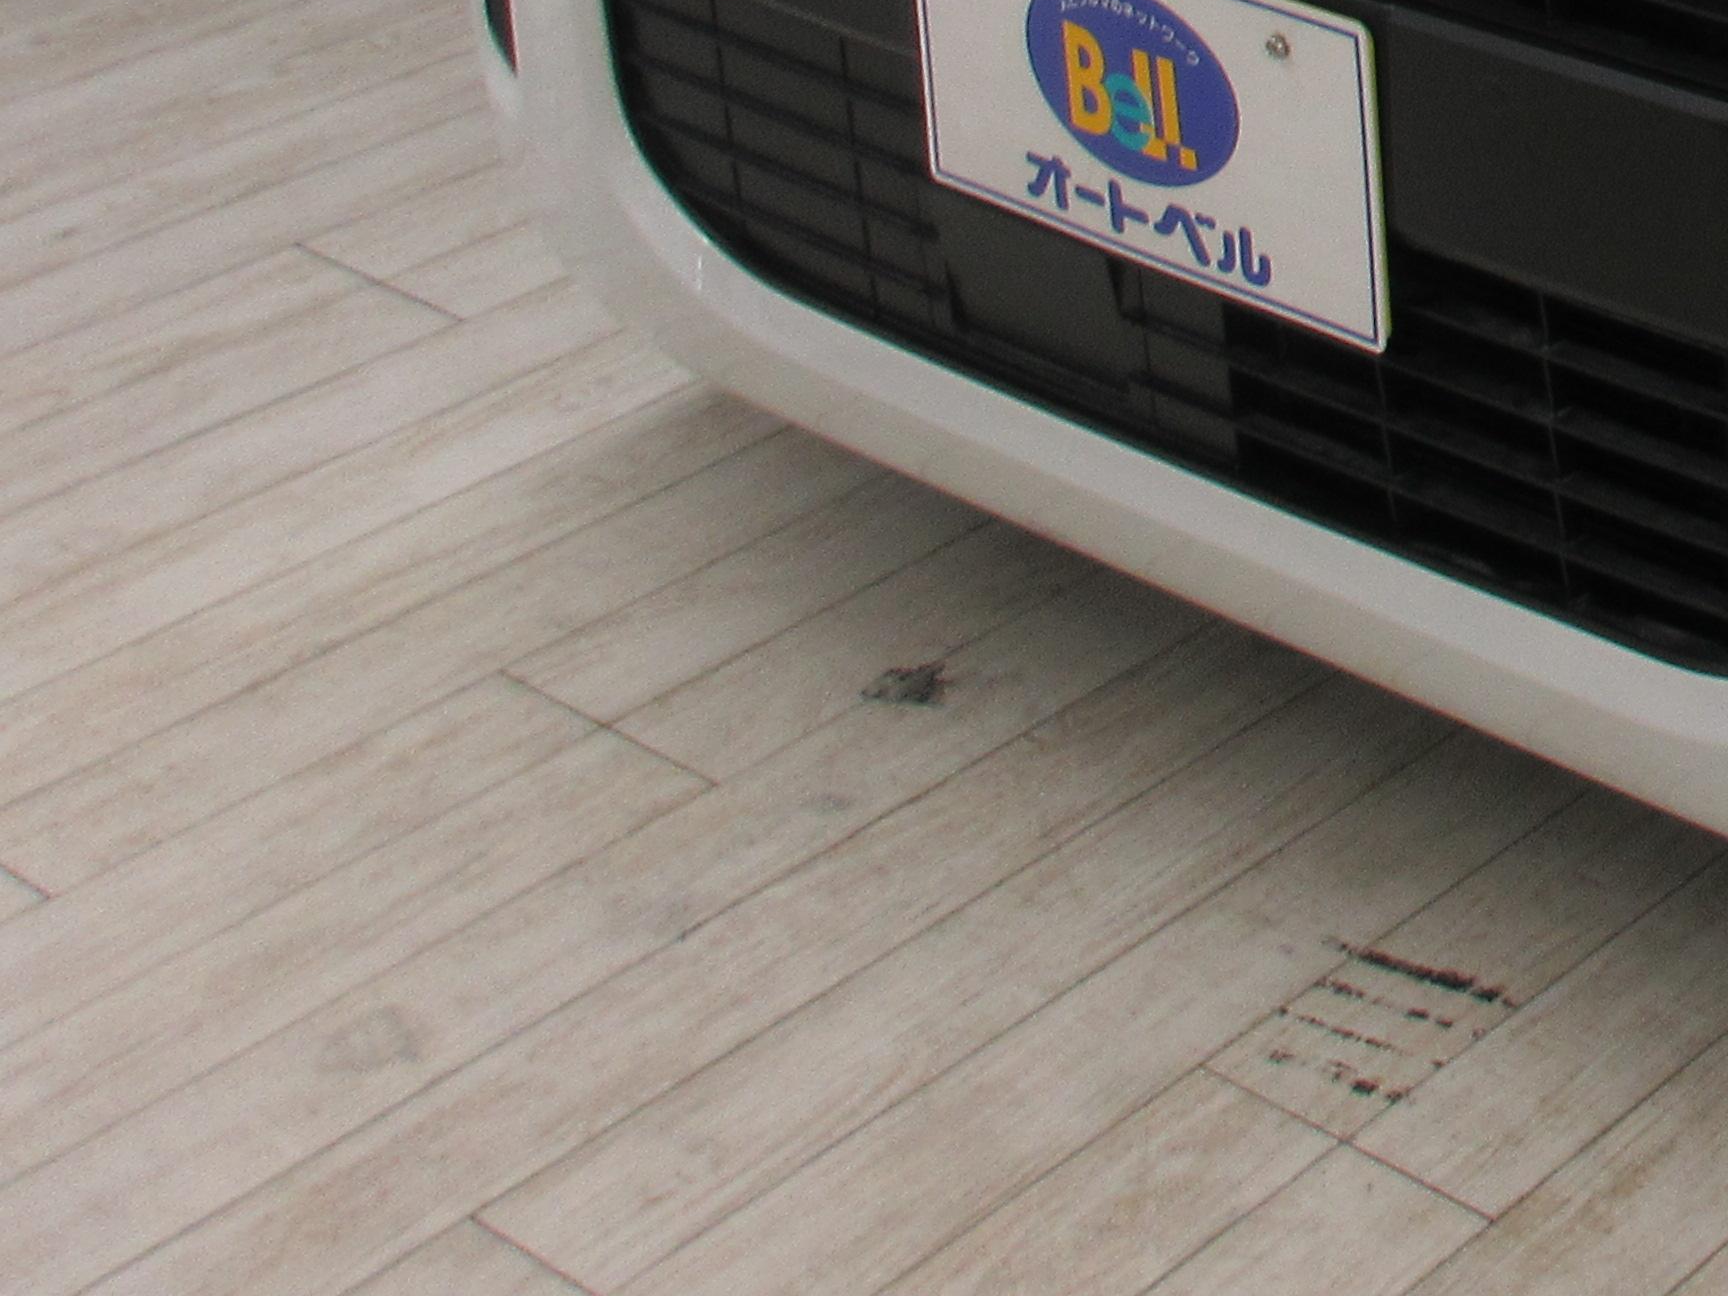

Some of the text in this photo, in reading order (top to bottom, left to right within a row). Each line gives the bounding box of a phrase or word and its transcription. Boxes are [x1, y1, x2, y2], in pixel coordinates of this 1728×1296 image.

[1026, 150, 1272, 288] オートベル
